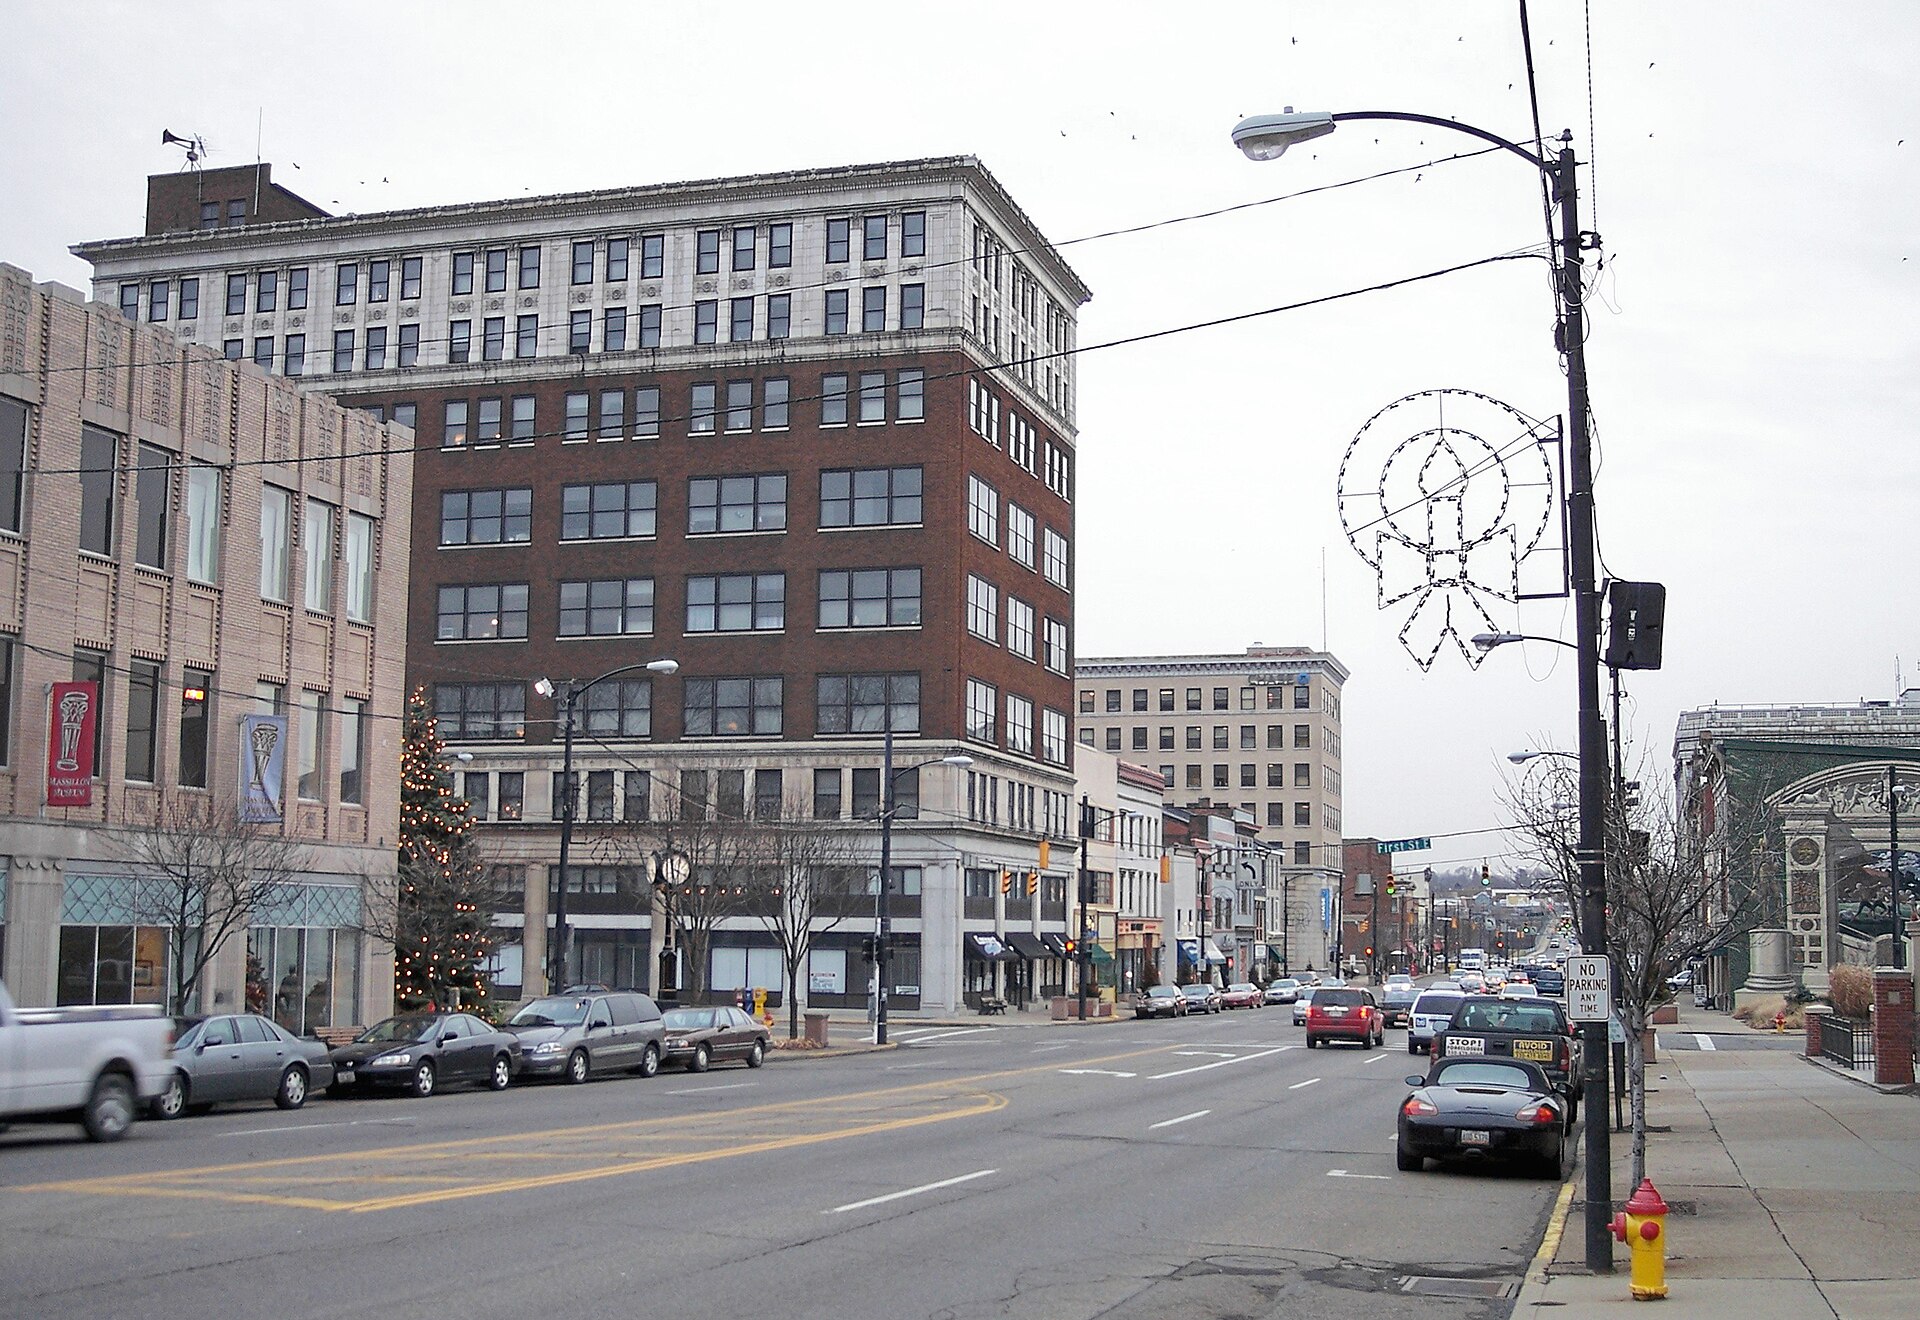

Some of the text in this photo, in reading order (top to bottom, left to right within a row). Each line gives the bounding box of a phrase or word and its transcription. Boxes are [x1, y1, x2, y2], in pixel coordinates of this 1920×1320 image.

[1377, 838, 1430, 853] First St E
[1580, 963, 1596, 976] NO
[1570, 978, 1607, 991] PARKING
[1580, 993, 1597, 1002] ANY
[1580, 1004, 1598, 1013] TIME
[1449, 1038, 1482, 1046] STOP!
[1519, 1041, 1547, 1050] AVOID
